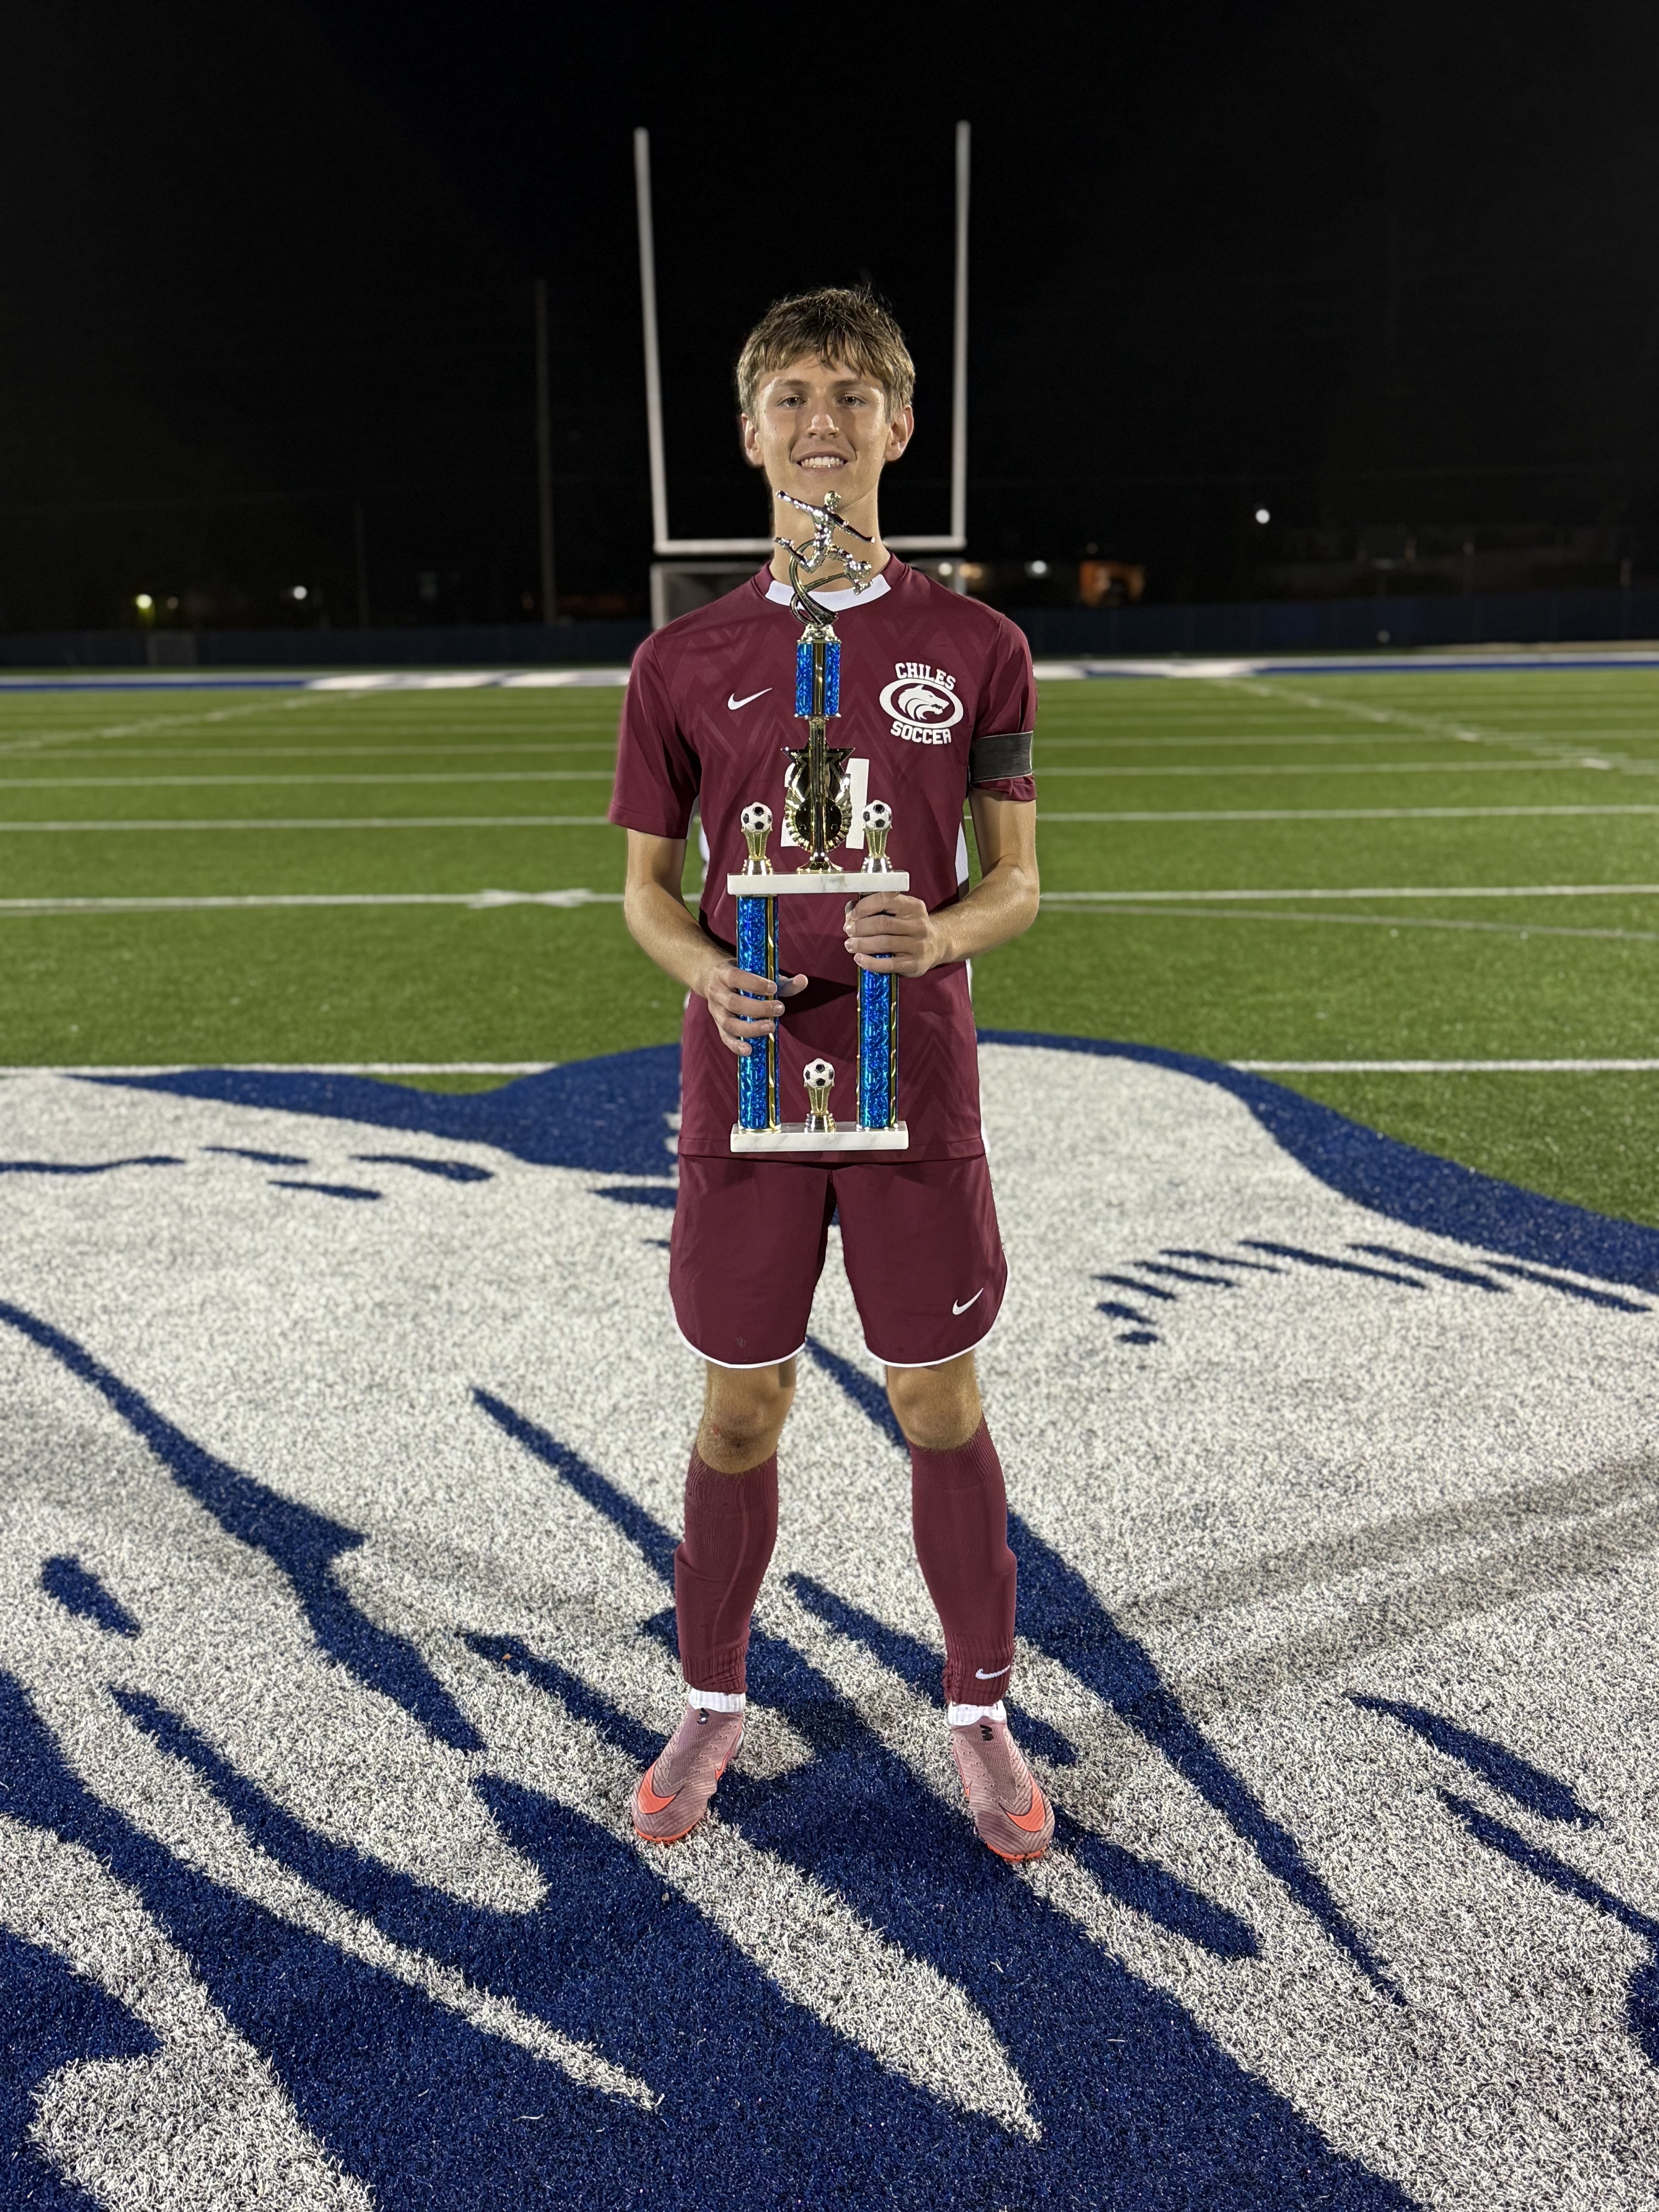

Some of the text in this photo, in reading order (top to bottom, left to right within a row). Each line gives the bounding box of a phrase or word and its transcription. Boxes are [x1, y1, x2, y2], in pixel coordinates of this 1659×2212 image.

[895, 663, 956, 690] CHILES
[890, 721, 951, 745] SOCCER
[781, 758, 869, 850] 1
